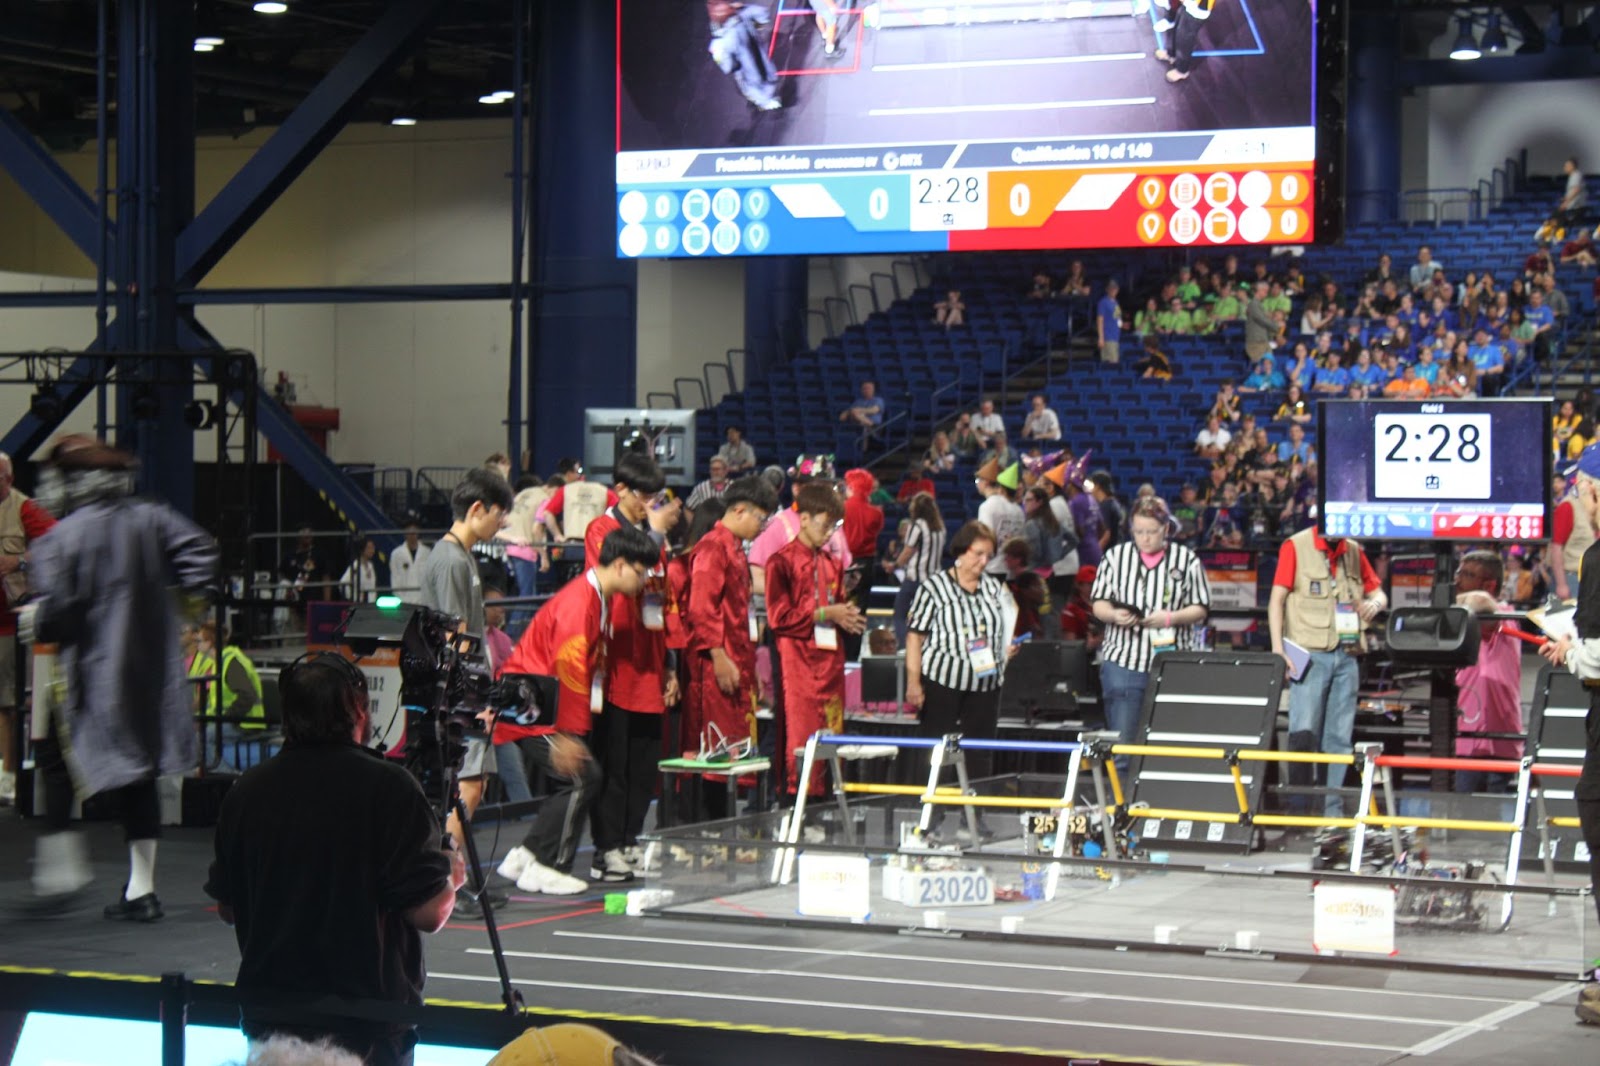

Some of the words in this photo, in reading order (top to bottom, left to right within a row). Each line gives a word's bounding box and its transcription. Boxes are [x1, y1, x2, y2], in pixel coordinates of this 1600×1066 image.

[1011, 144, 1091, 164] Qualification
[868, 188, 889, 220] 0
[919, 176, 979, 204] 2:28
[1009, 183, 1030, 216] 0
[1385, 424, 1481, 463] 2:28
[1033, 815, 1087, 834] 2552
[920, 876, 988, 903] 23020
